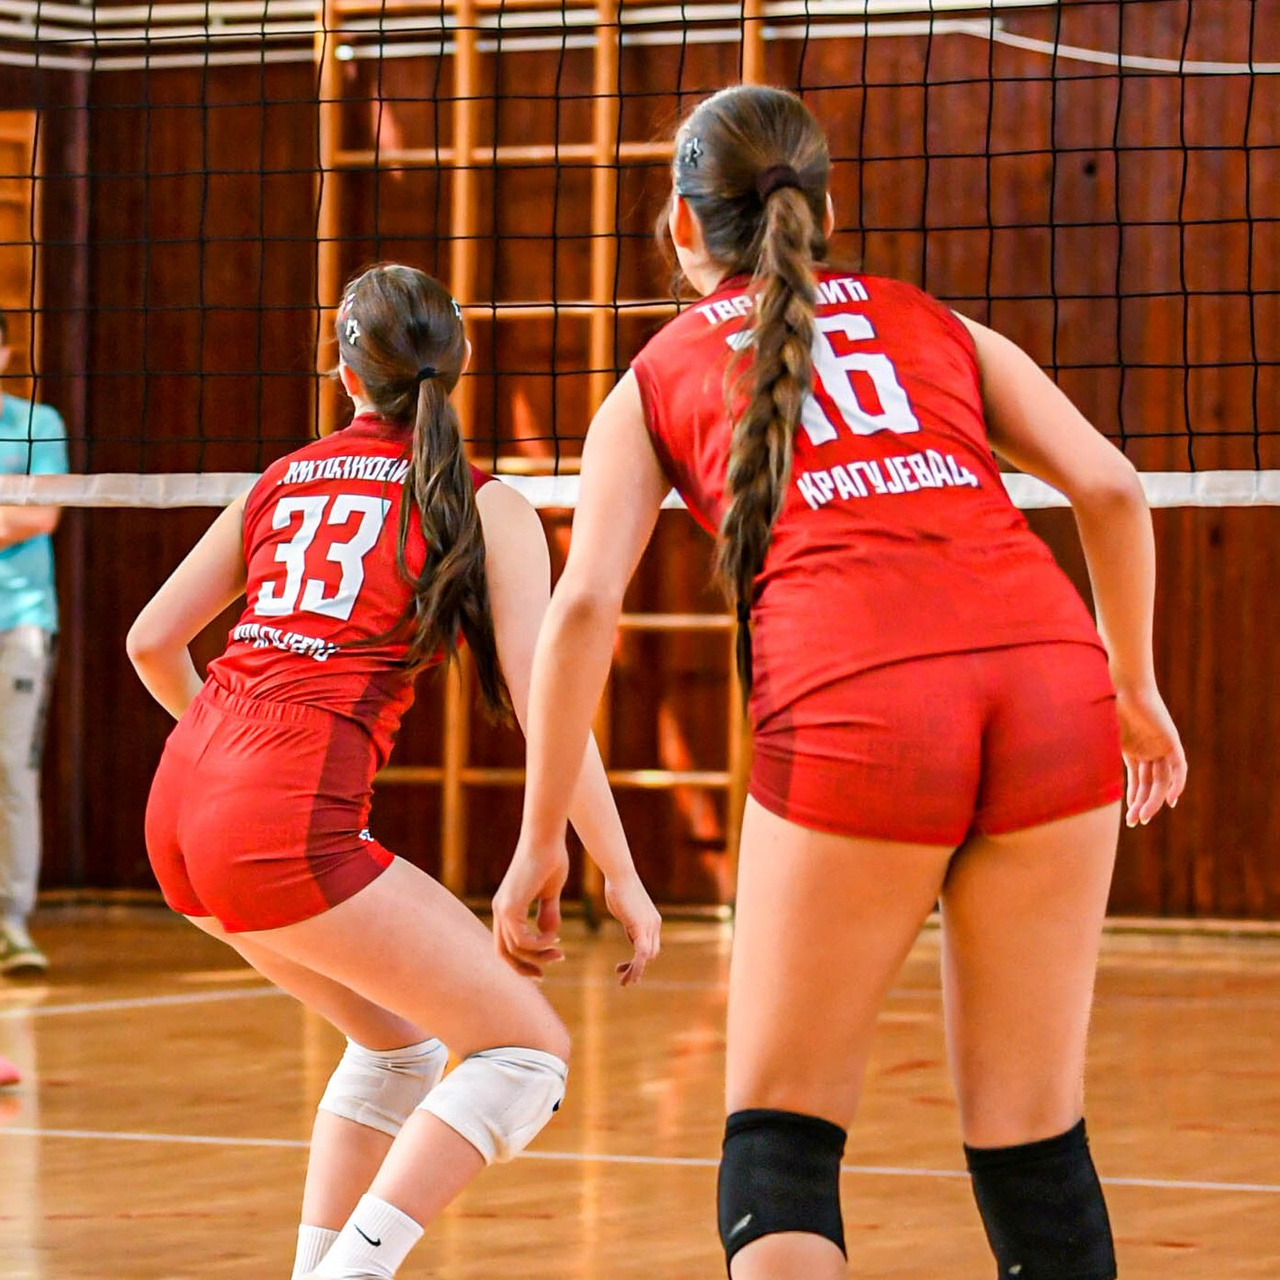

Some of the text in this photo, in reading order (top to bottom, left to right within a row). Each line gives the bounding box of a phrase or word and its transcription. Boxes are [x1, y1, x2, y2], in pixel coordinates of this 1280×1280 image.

[694, 277, 869, 325] ТВРИЋ
[796, 449, 980, 511] КРАГУЈЕВАЦ
[254, 494, 392, 621] 33
